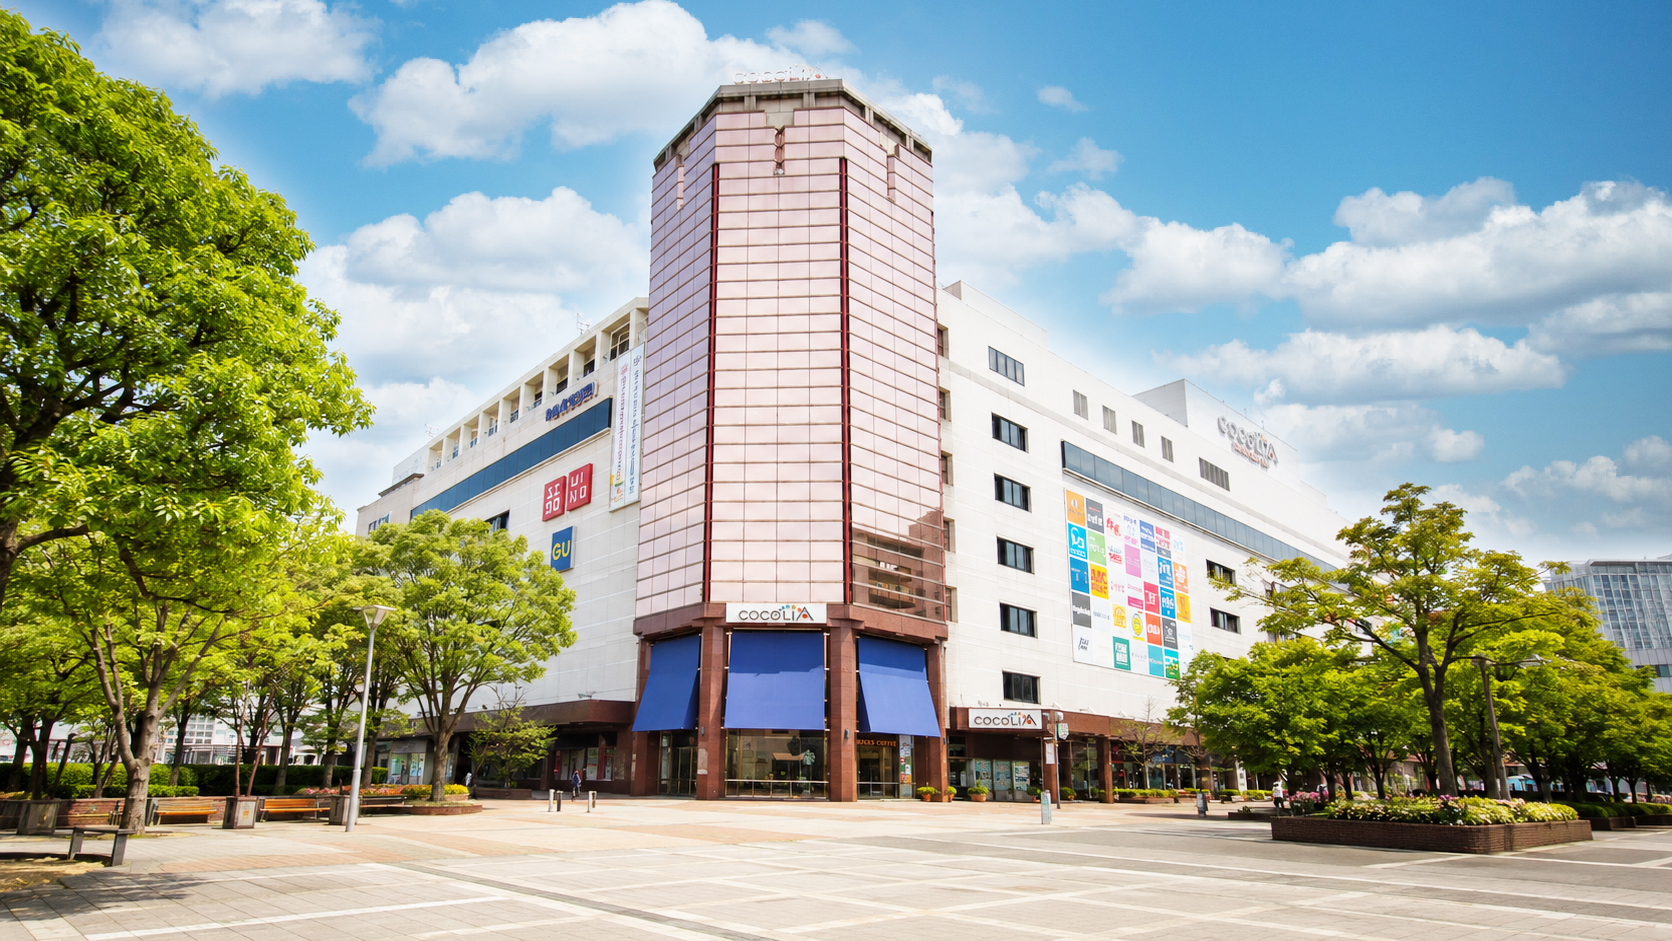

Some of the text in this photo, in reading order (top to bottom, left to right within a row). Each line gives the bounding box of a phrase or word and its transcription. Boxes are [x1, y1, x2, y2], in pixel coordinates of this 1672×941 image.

[552, 540, 571, 560] GU
[739, 606, 814, 621] COCOLIA
[974, 713, 1037, 726] COCOLIA
